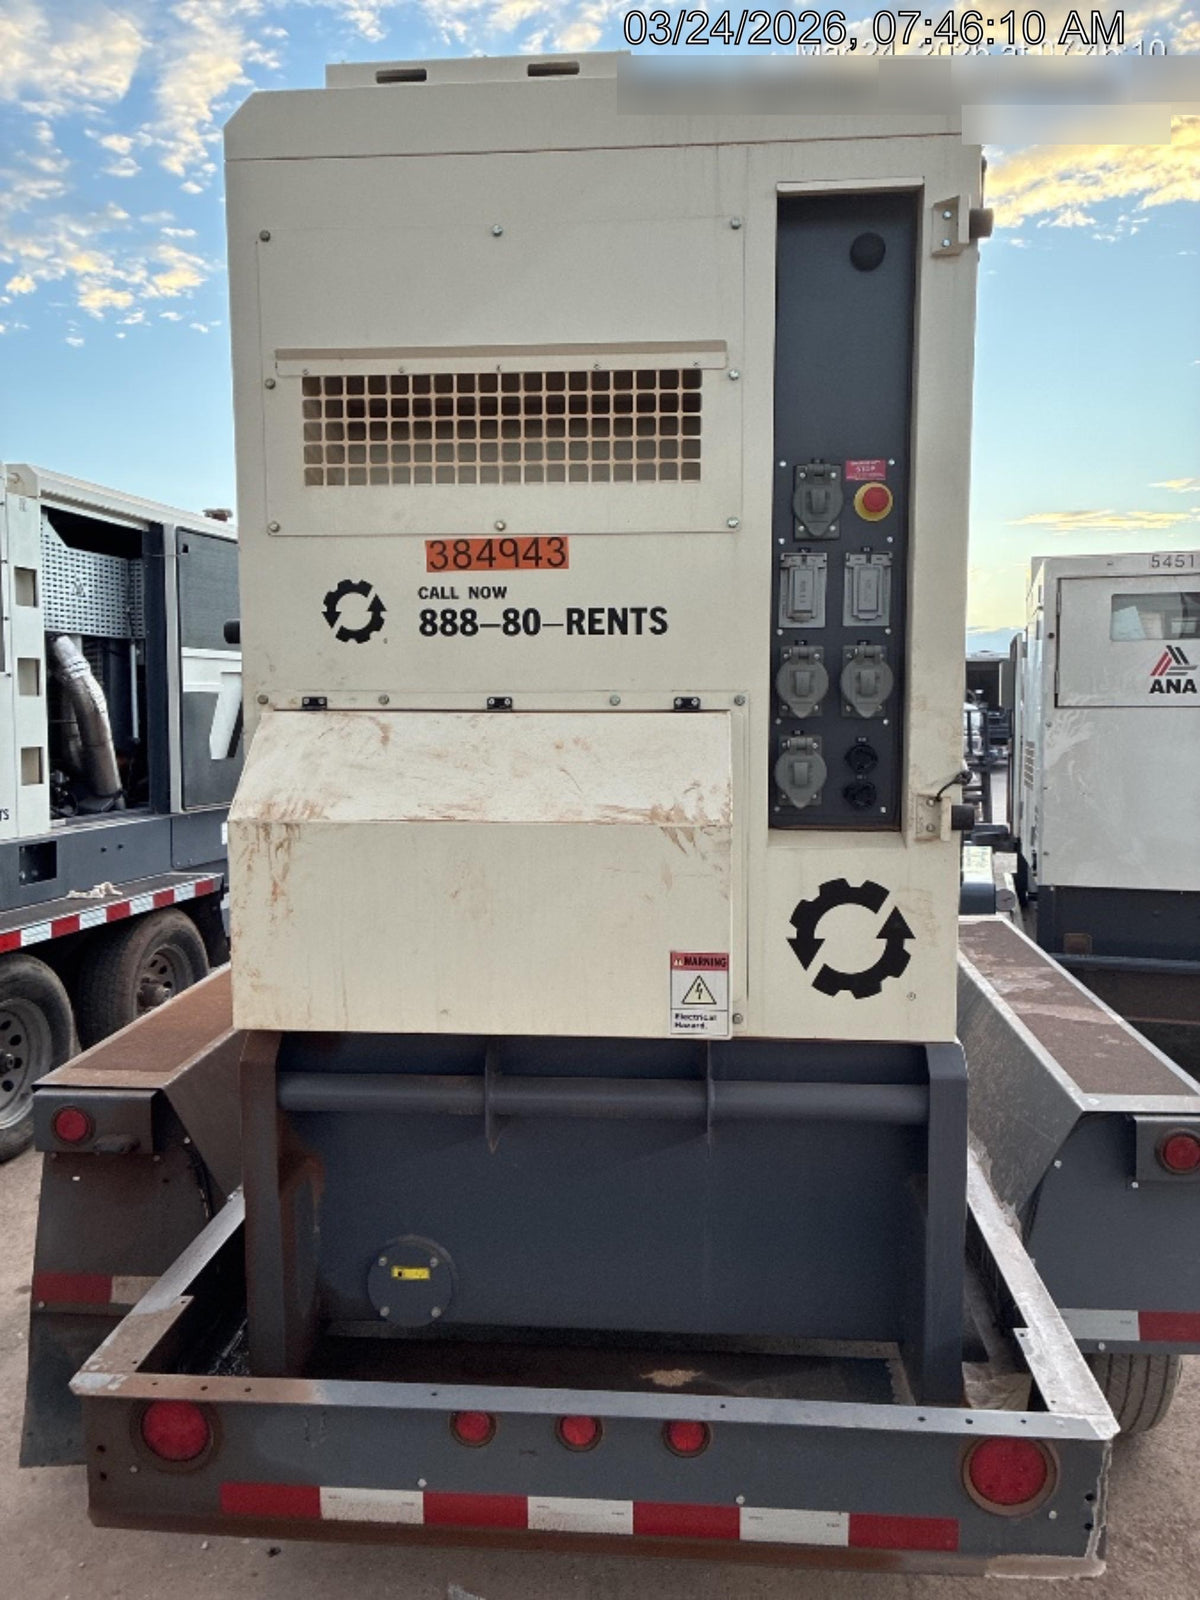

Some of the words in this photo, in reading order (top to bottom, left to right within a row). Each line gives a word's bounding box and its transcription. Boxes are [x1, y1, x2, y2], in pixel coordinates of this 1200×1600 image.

[429, 537, 566, 570] 384943
[1151, 555, 1195, 568] 5451
[418, 586, 459, 600] CALL
[468, 586, 508, 600] NOW
[1149, 679, 1198, 694] ANA
[684, 956, 727, 967] WARNING
[674, 1013, 717, 1021] Electrical
